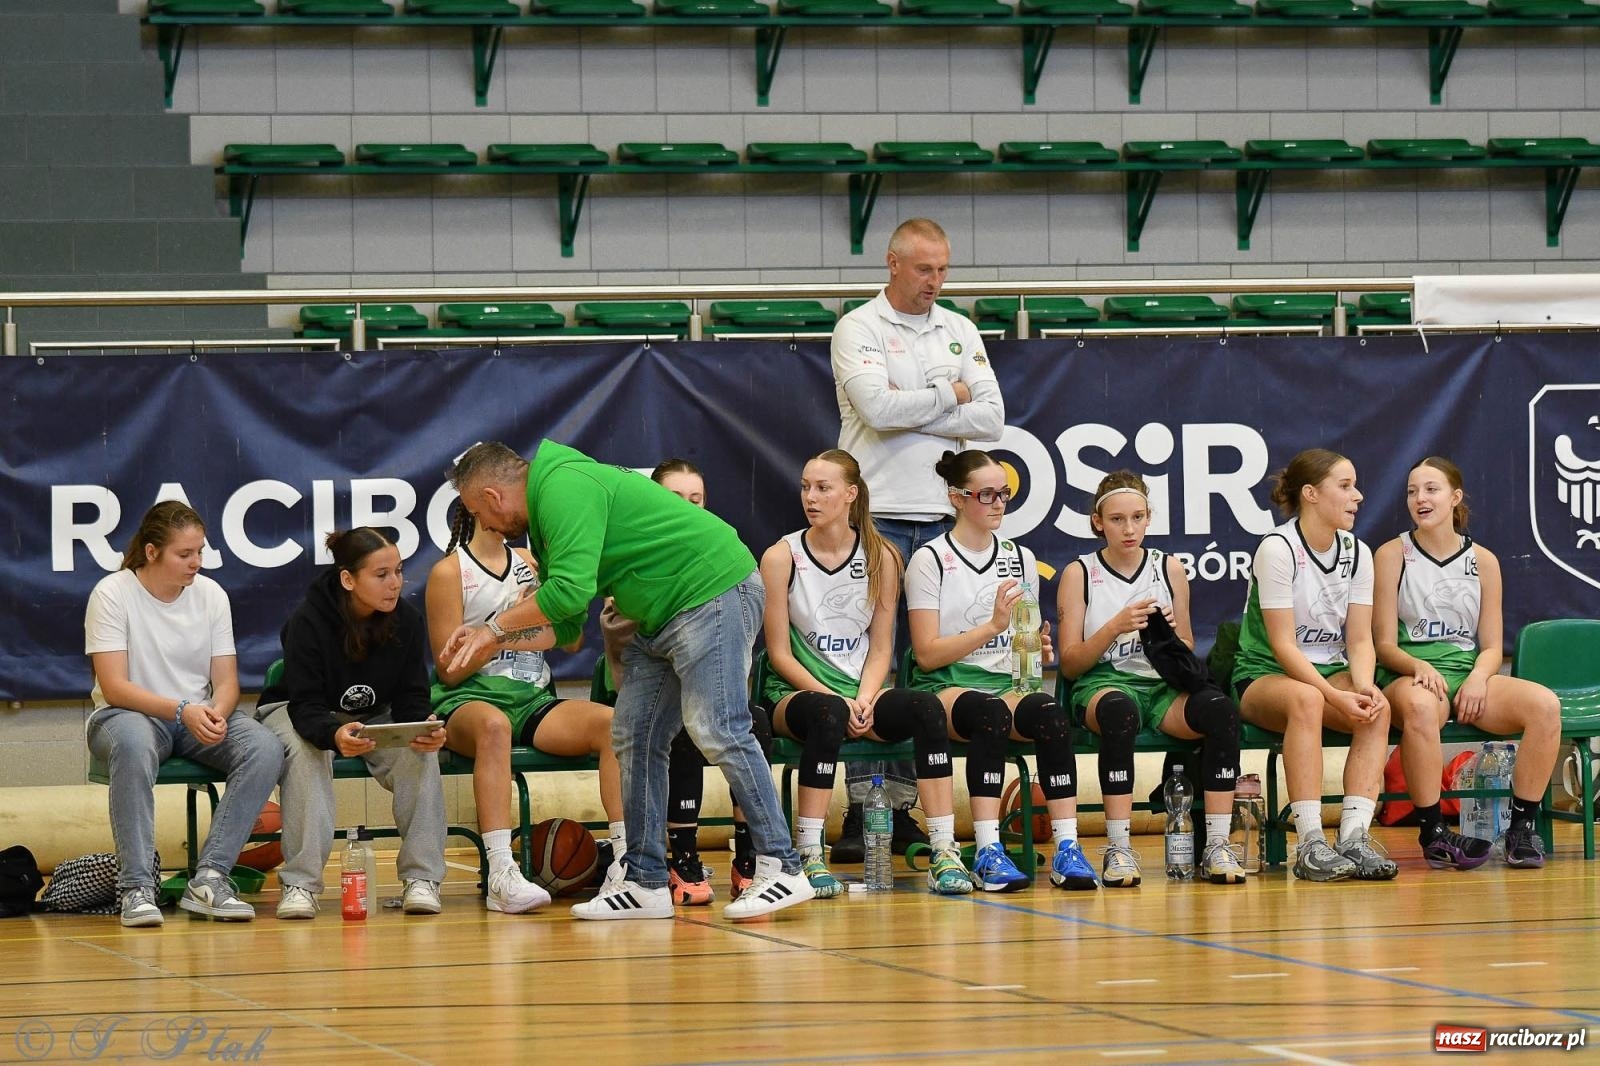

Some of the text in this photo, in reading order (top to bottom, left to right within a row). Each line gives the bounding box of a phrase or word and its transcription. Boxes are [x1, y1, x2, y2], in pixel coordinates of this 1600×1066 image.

[934, 752, 949, 765] NBA
[1056, 773, 1072, 786] NBA
[1114, 770, 1128, 781] NBA
